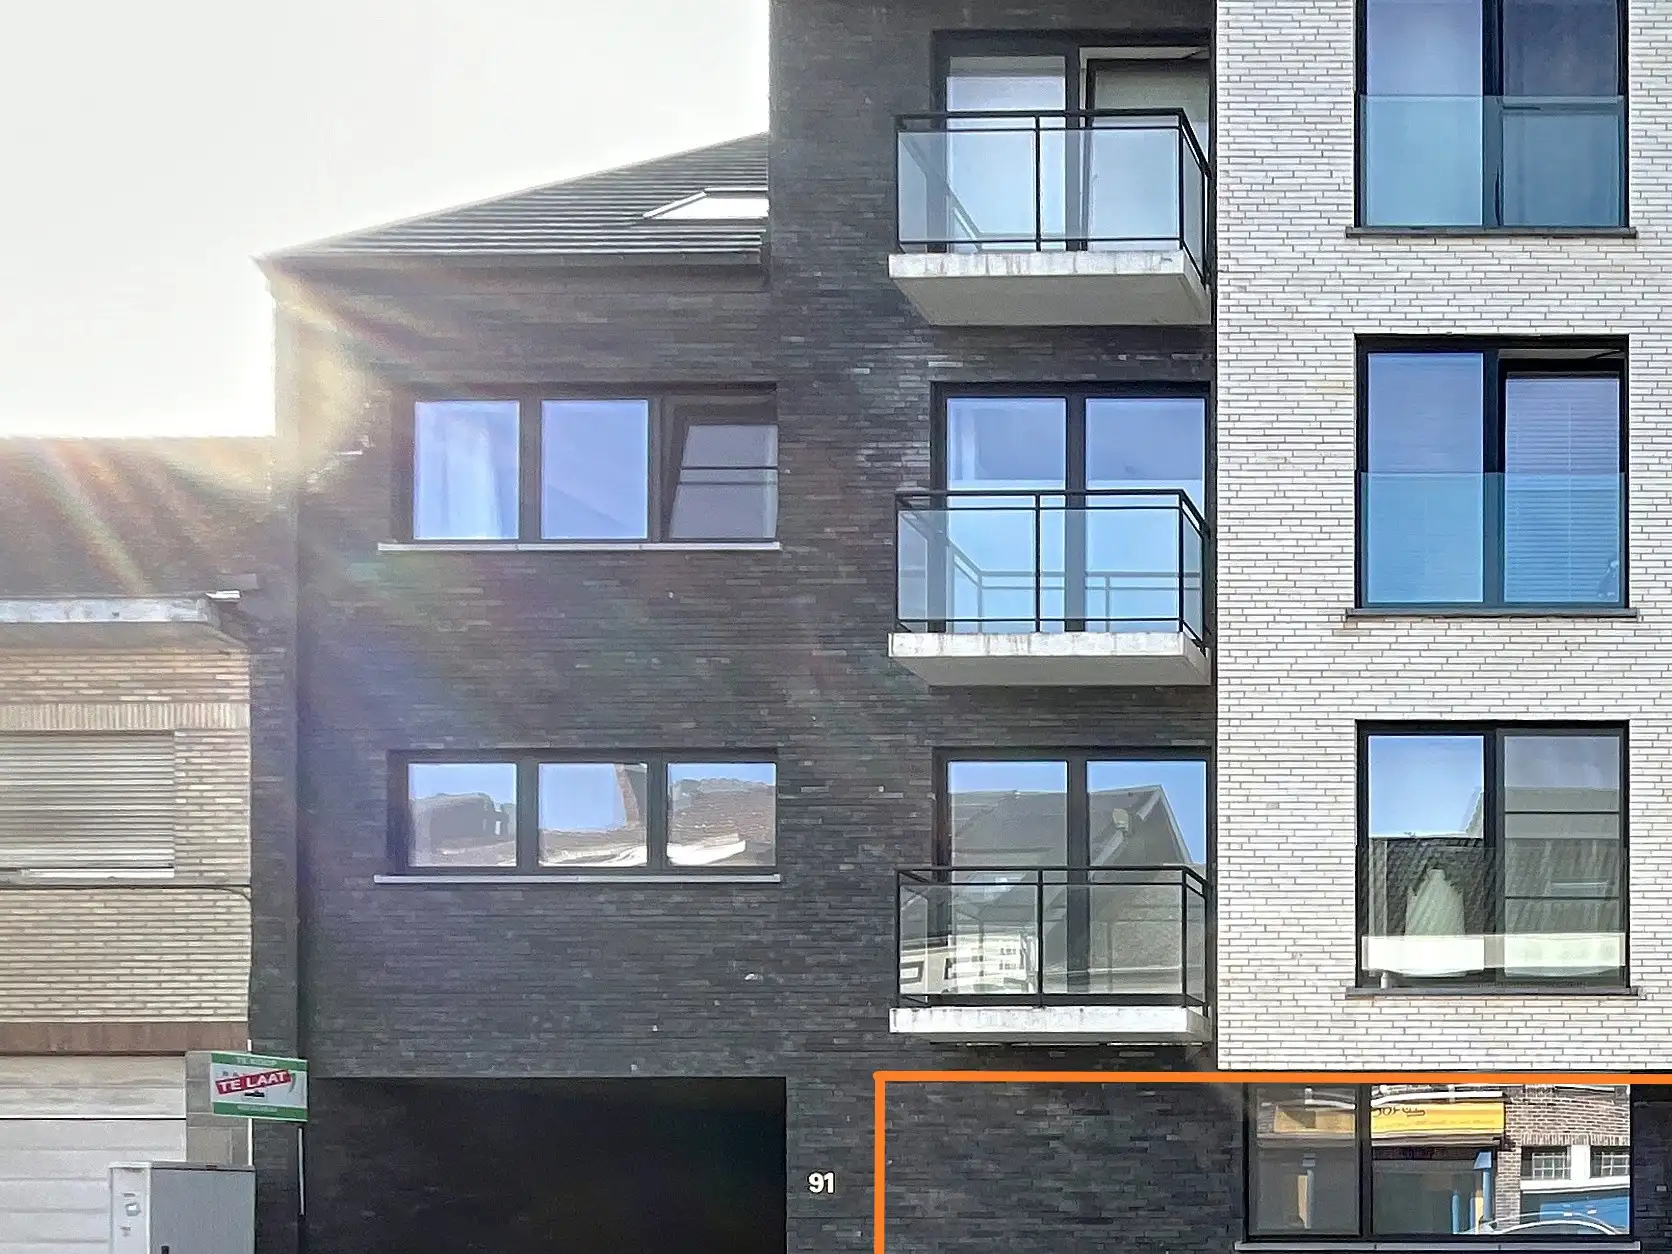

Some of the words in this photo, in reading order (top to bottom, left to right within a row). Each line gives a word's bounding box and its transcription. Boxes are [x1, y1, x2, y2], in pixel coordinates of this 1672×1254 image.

[219, 1079, 241, 1092] TE
[246, 1071, 287, 1088] LAAT
[808, 1172, 834, 1193] 91
